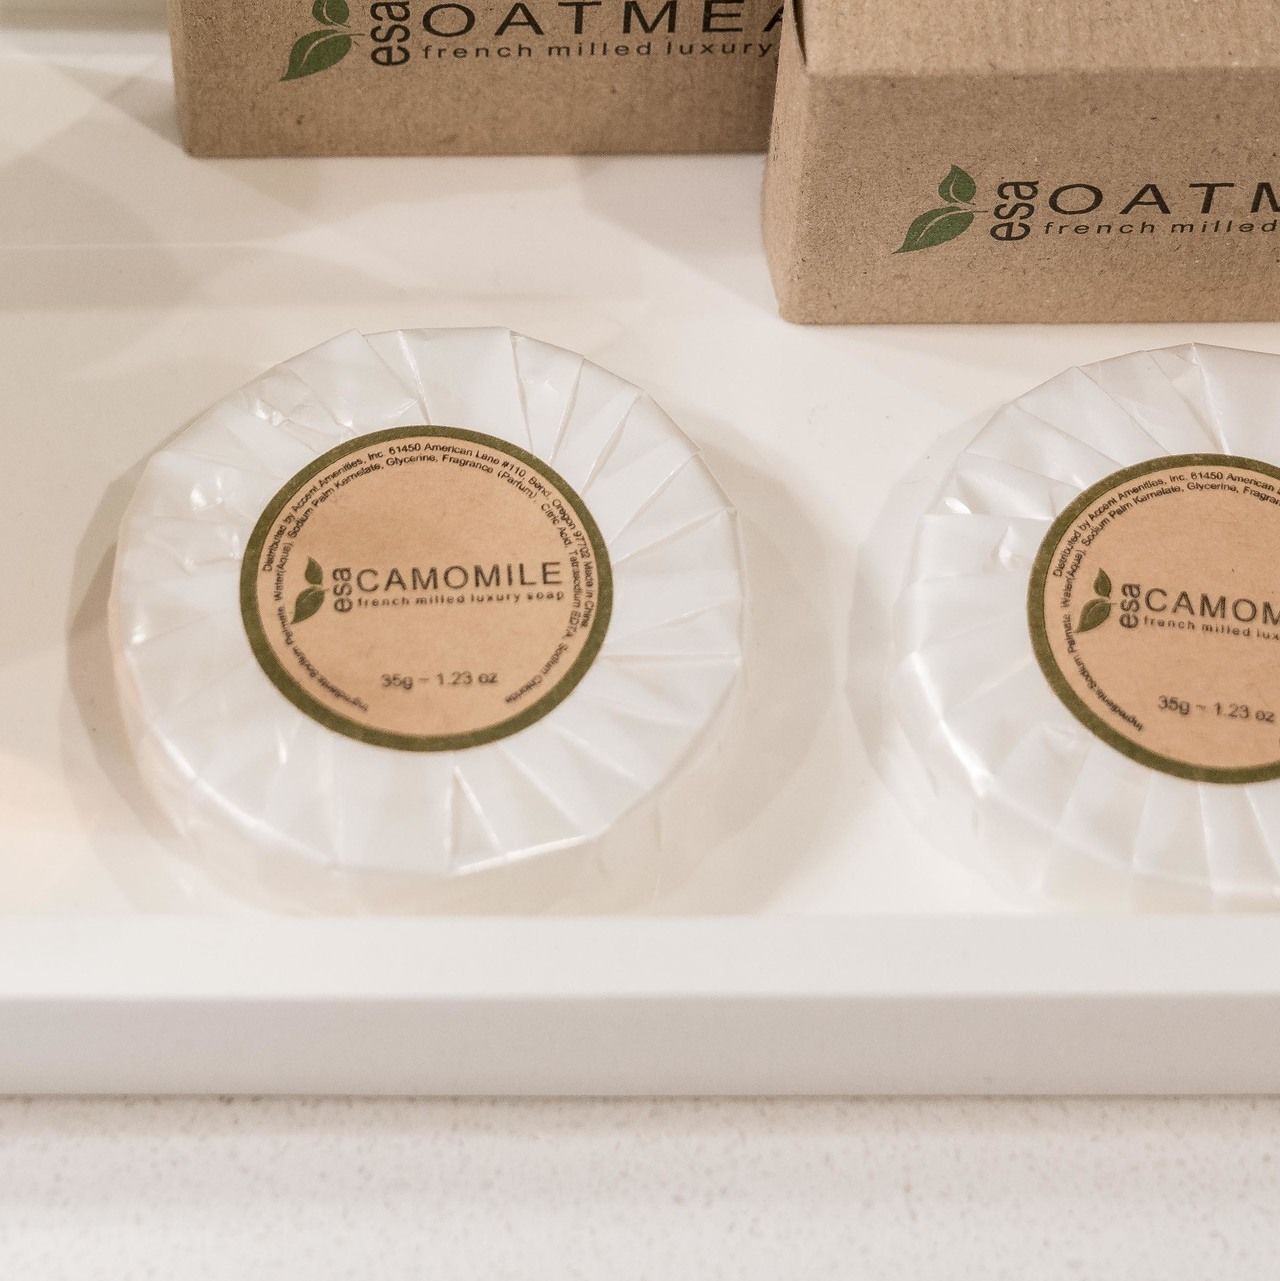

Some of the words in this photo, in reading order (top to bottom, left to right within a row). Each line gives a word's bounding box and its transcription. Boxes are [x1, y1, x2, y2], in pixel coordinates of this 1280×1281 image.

[370, 1, 410, 66] esa
[422, 43, 532, 60] french
[547, 41, 652, 57] milled
[665, 40, 773, 59] luxury
[990, 181, 1039, 241] esa
[1043, 220, 1155, 235] french
[1170, 218, 1278, 234] milled
[310, 487, 335, 508] Palm
[441, 453, 494, 474] Fragrance
[540, 503, 560, 525] Citric
[261, 524, 288, 572] Distributed
[282, 512, 296, 525] by
[290, 485, 320, 513] Accent
[388, 442, 422, 456] 61450
[423, 442, 473, 457] American
[474, 450, 500, 465] Lane
[501, 460, 527, 478] #110,
[551, 499, 577, 531] Oregon
[572, 530, 591, 559] 97702
[583, 561, 594, 588] Made
[1052, 529, 1082, 578] Distributed
[1077, 519, 1092, 532] by
[1087, 497, 1118, 522] Accent
[1190, 471, 1224, 481] 61450
[1225, 472, 1275, 492] American
[1107, 502, 1134, 520] Palm
[332, 568, 352, 613] esa
[357, 562, 563, 592] CAMOMILE
[357, 596, 410, 608] french
[415, 594, 465, 605] milled
[470, 593, 521, 604] luxury
[526, 590, 565, 601] soap
[1119, 584, 1140, 628] esa
[1143, 615, 1196, 631] french
[1201, 623, 1251, 638] milled
[381, 673, 414, 691] 35g
[436, 670, 474, 687] 1.23
[477, 672, 498, 685] oz
[1158, 695, 1191, 717] 35g
[1214, 702, 1251, 720] 1.23
[1254, 710, 1275, 724] oz
